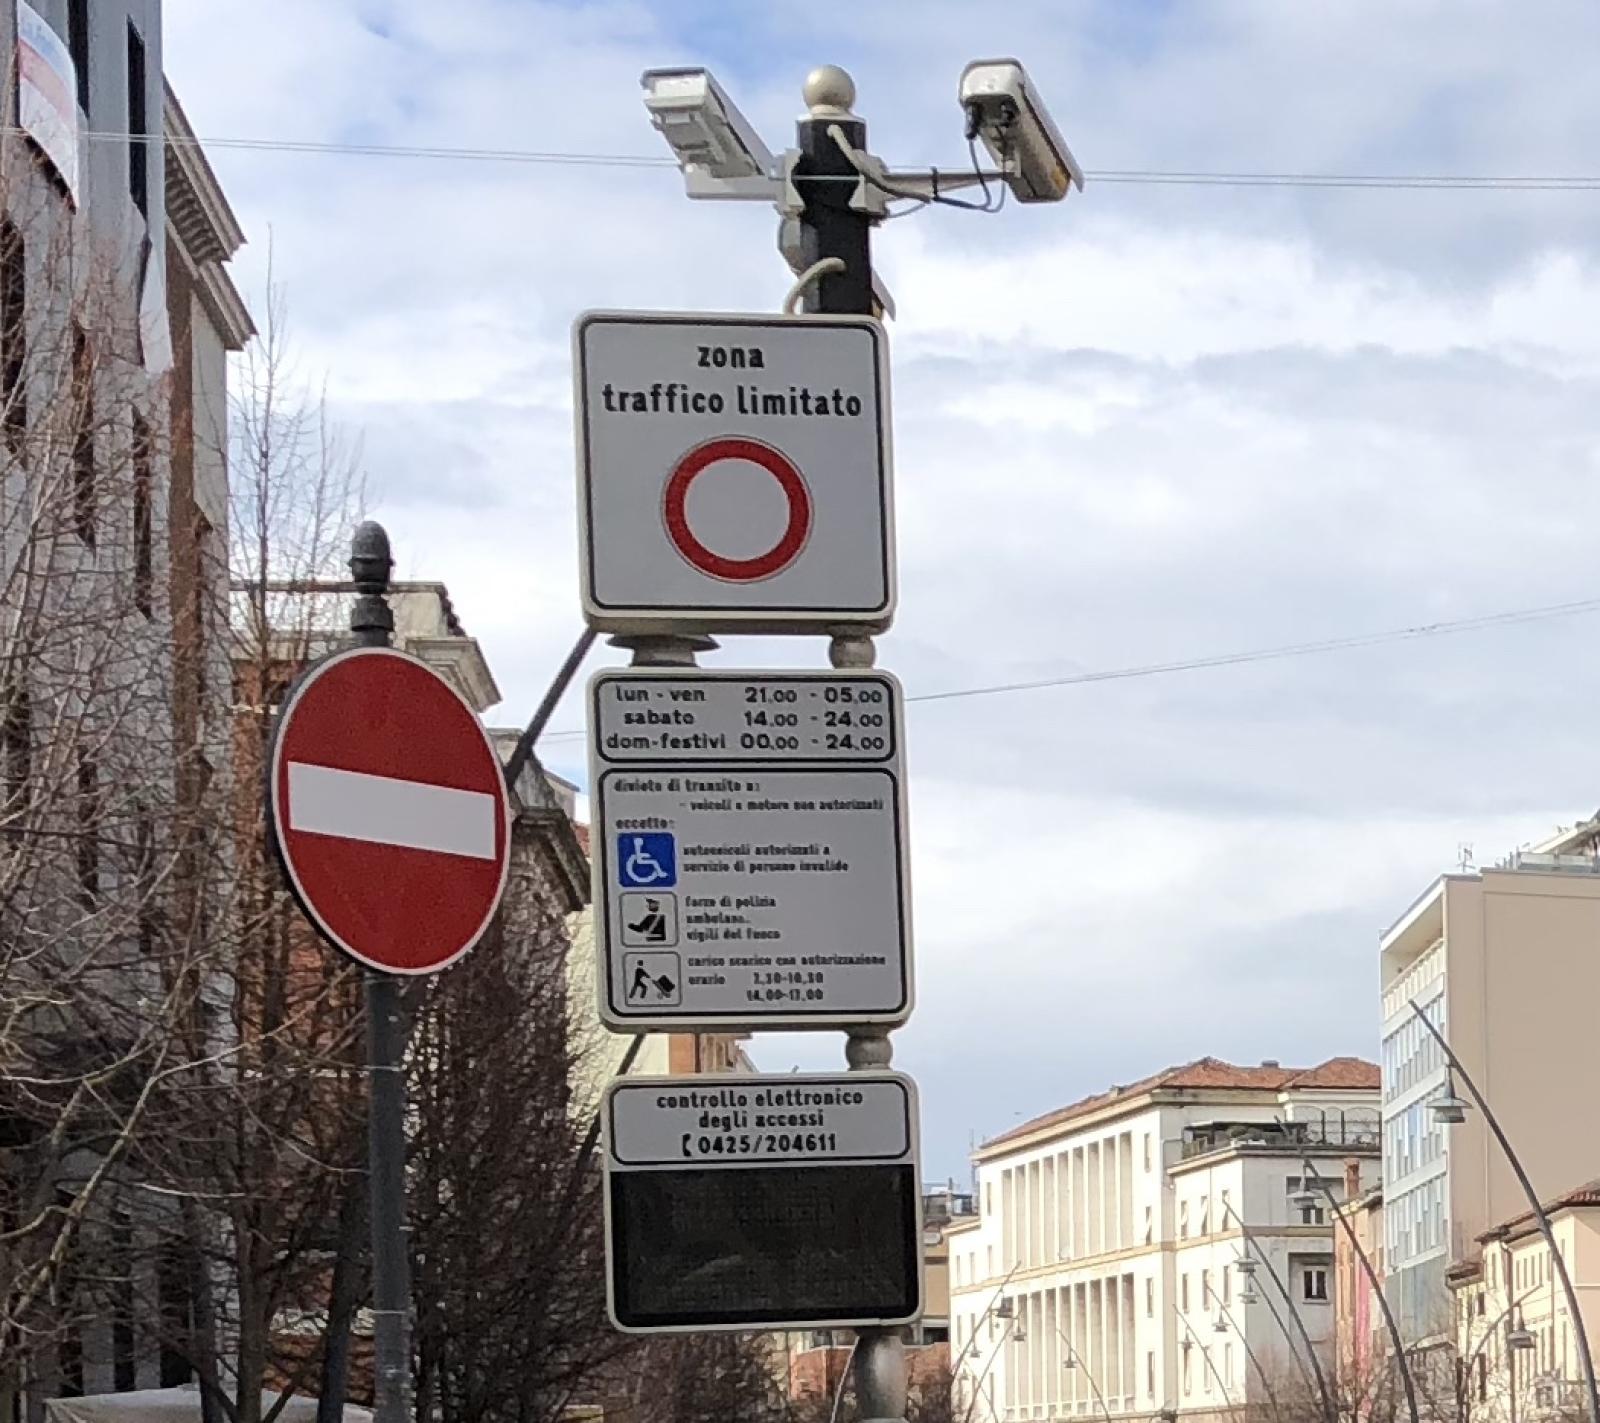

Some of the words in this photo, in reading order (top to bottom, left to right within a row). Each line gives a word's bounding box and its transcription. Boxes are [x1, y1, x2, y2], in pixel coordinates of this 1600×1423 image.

[697, 346, 765, 369] zona
[602, 383, 724, 413] traffico
[737, 385, 862, 416] limitato
[616, 684, 649, 701] lun
[669, 688, 706, 701] ven
[624, 709, 695, 725] sabato
[606, 732, 726, 749] dom-festivi
[667, 778, 680, 792] di
[685, 778, 741, 792] transito
[733, 860, 745, 872] di
[720, 895, 732, 907] di
[656, 1091, 747, 1109] controllo
[755, 1088, 863, 1107] elettronico
[699, 1110, 747, 1132] degli
[755, 1109, 824, 1127] accessi
[698, 1132, 836, 1154] 0425/204611
